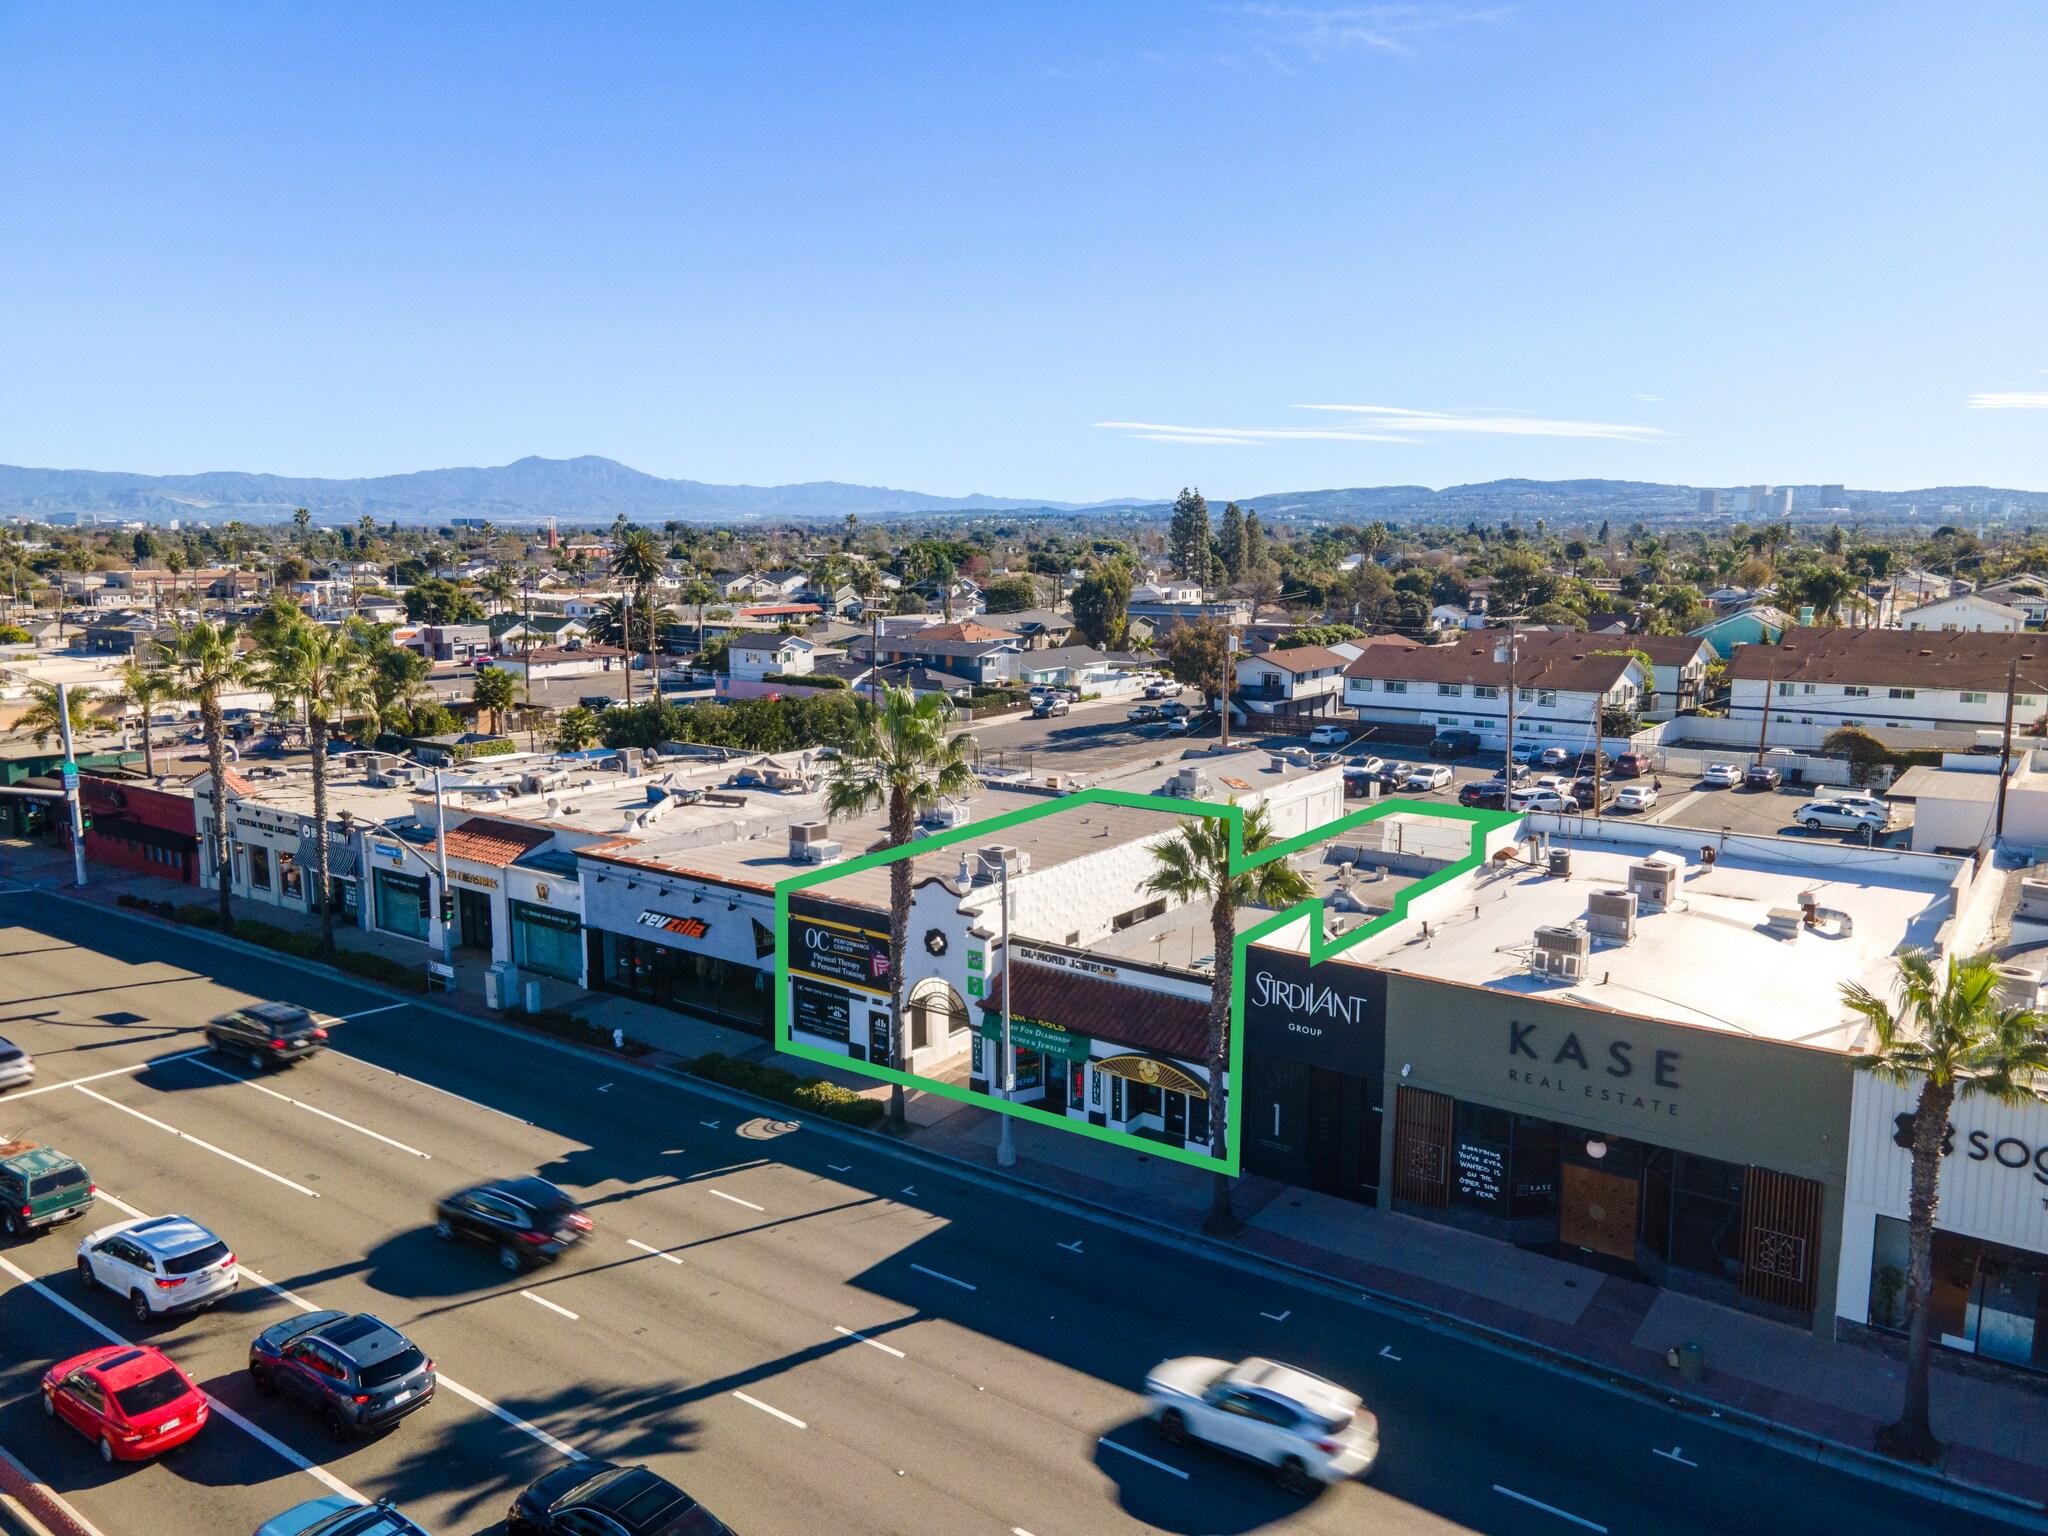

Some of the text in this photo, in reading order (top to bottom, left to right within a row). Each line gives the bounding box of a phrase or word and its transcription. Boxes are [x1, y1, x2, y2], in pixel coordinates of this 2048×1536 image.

[236, 818, 258, 828] CUSTOM
[258, 822, 274, 832] HOUSE
[274, 826, 299, 838] LIGHTING
[636, 911, 708, 938] revzilla
[806, 928, 869, 951] OC PERFORMANCE
[834, 944, 853, 952] CENTER
[814, 953, 860, 970] Physical Therapy
[818, 962, 841, 973] Personal
[842, 968, 866, 981] Training
[1020, 1025, 1033, 1034] FOR
[1035, 1030, 1070, 1043] DIAMONDS
[1038, 1020, 1066, 1032] GOLD
[1288, 1023, 1322, 1036] GROUP
[1000, 1031, 1030, 1045] TCHES
[1036, 1040, 1066, 1054] JEWELRY
[1510, 1022, 1680, 1089] KASE
[1017, 1076, 1036, 1086] REPAIR
[1509, 1069, 1678, 1116] REAL ESTATE
[1458, 1151, 1503, 1169] YOU'VE EVER
[1462, 1144, 1500, 1160] EVERYTHING
[1460, 1160, 1490, 1173] WANTED
[1459, 1177, 1500, 1192] OTHER SIDE
[1480, 1174, 1493, 1182] THE
[1476, 1190, 1496, 1200] FEAR
